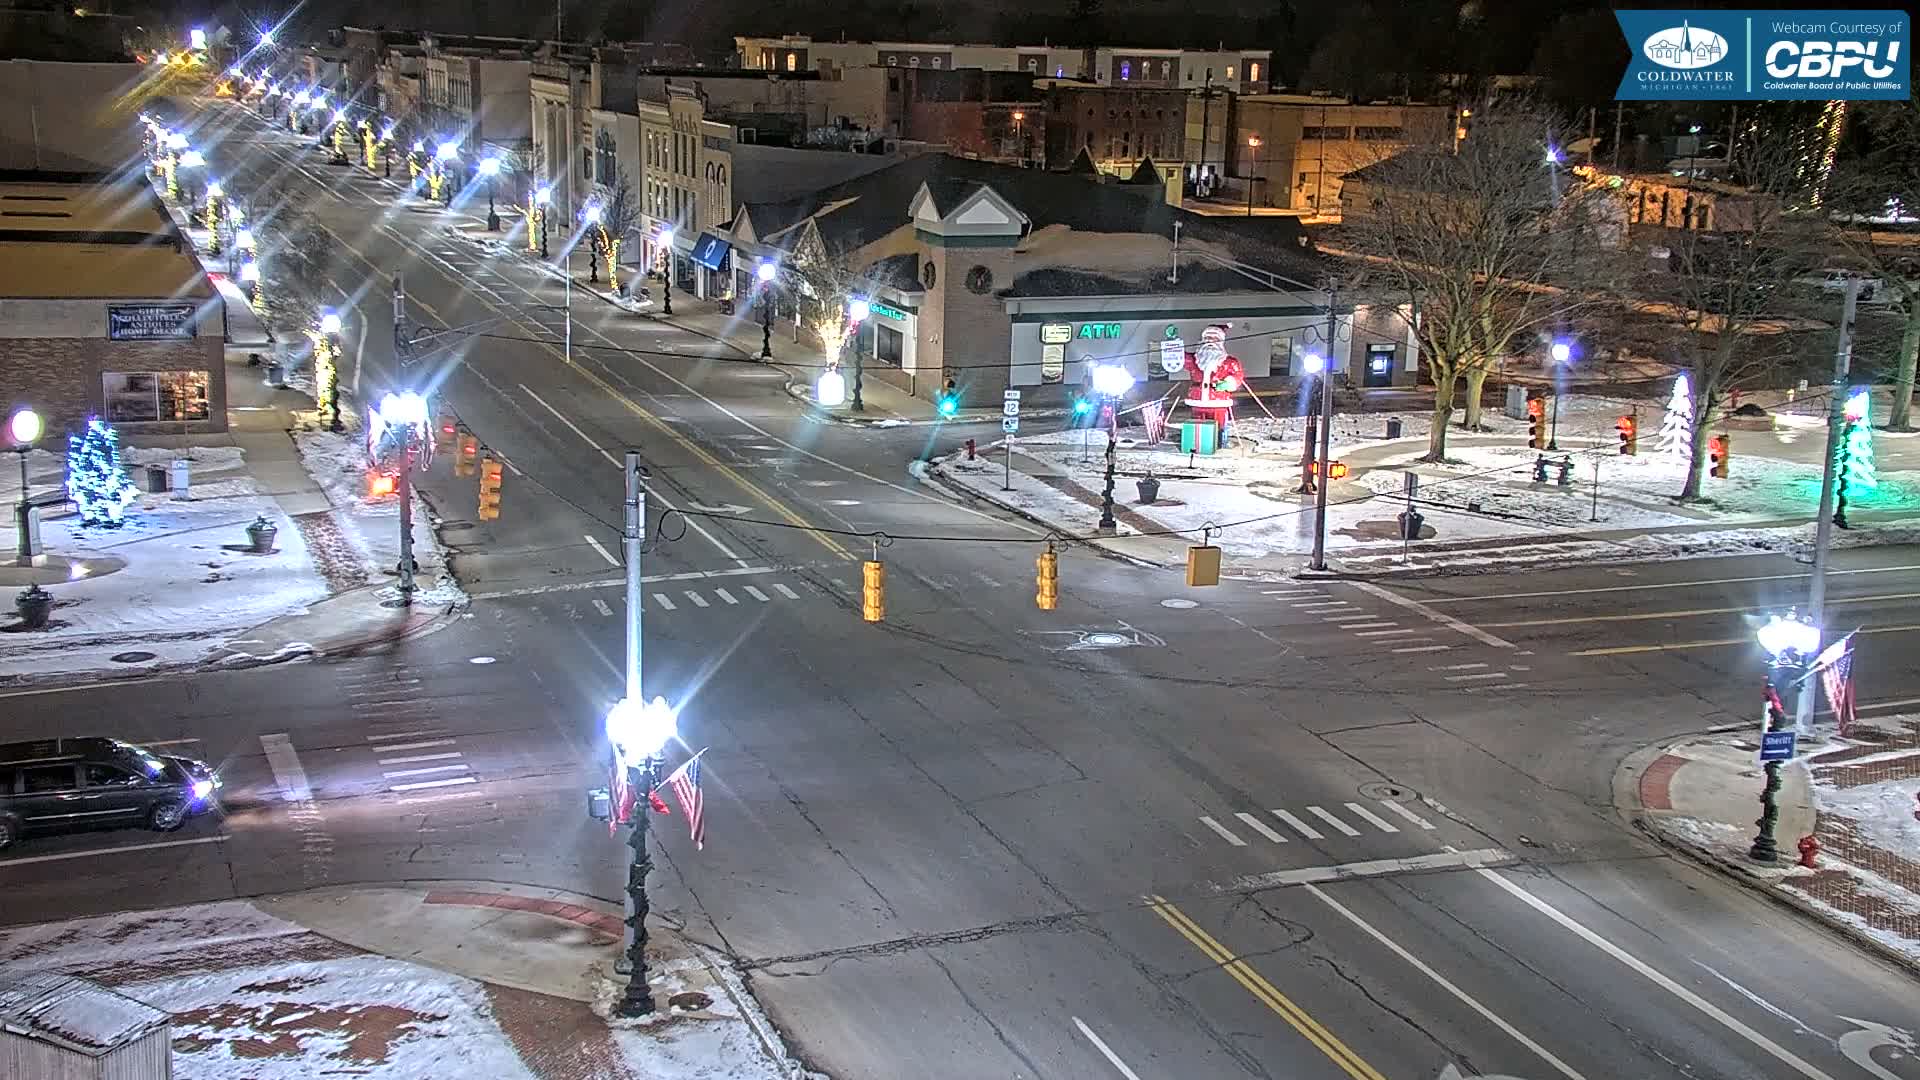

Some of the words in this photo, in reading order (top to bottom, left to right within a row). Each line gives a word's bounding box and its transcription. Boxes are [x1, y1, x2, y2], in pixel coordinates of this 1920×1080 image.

[130, 321, 177, 329] ANTIQUES
[1077, 323, 1121, 339] ATM
[1006, 403, 1017, 413] 12
